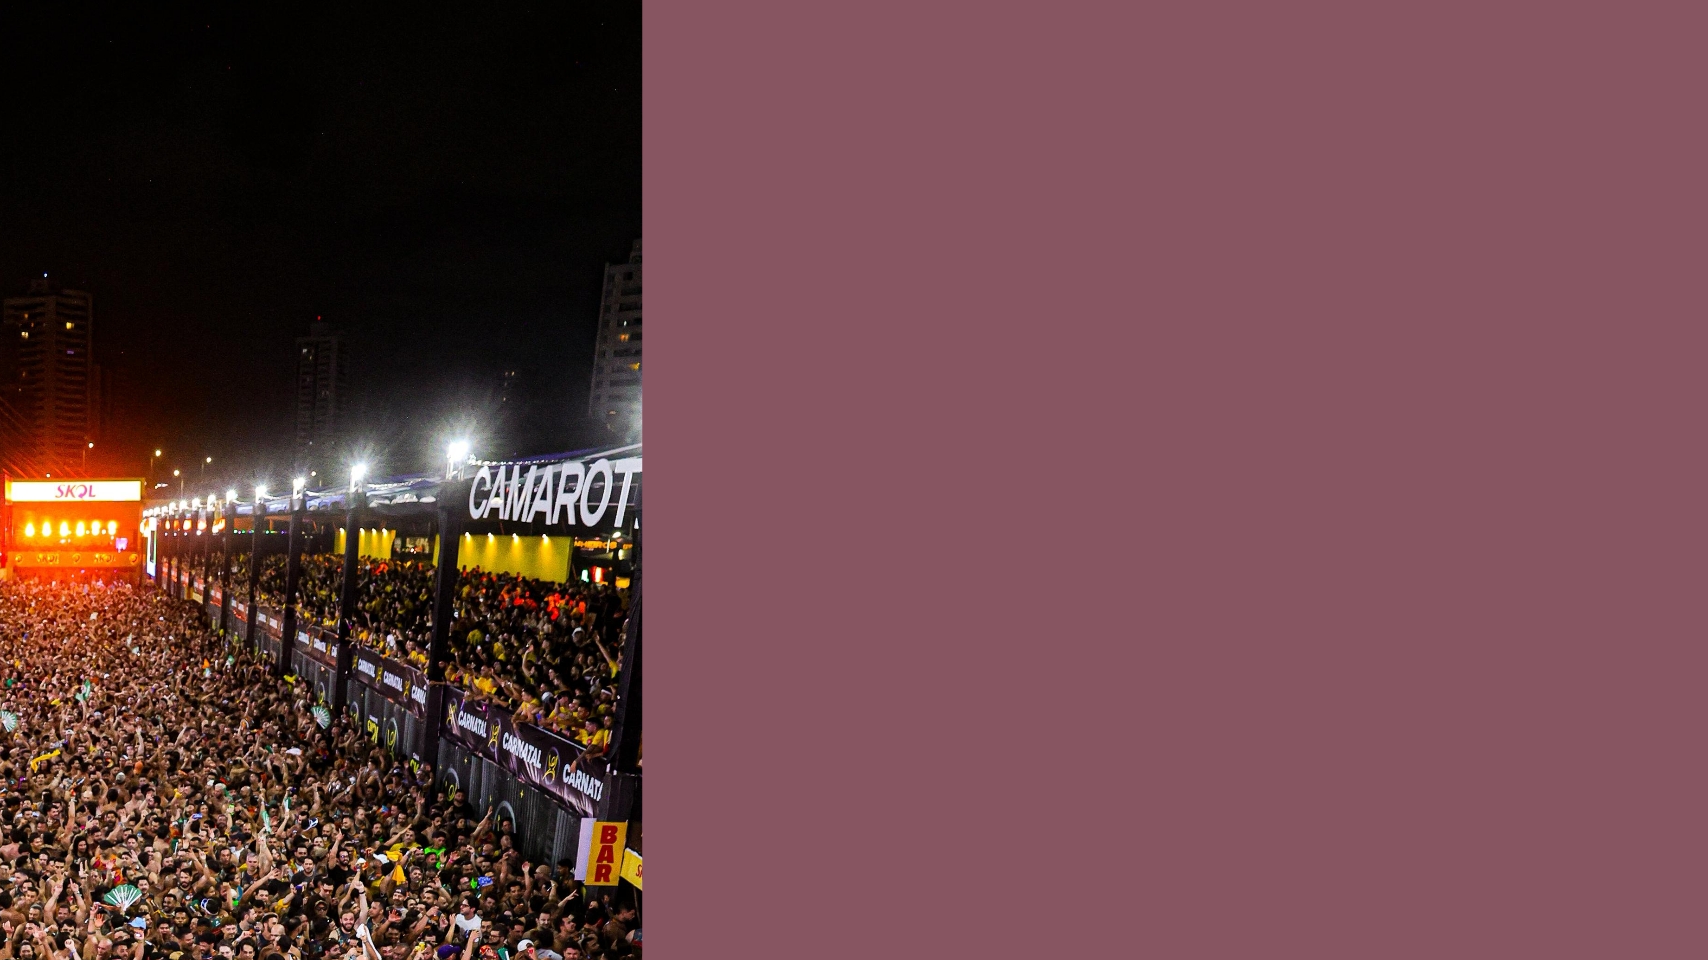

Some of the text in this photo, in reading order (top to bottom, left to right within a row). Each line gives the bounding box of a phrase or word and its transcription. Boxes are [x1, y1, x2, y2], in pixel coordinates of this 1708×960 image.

[55, 484, 96, 499] SKOL
[470, 458, 642, 529] CAMAROT
[458, 711, 487, 738] CARNATAL
[502, 732, 542, 769] CARNATAL
[594, 825, 618, 883] BAR
